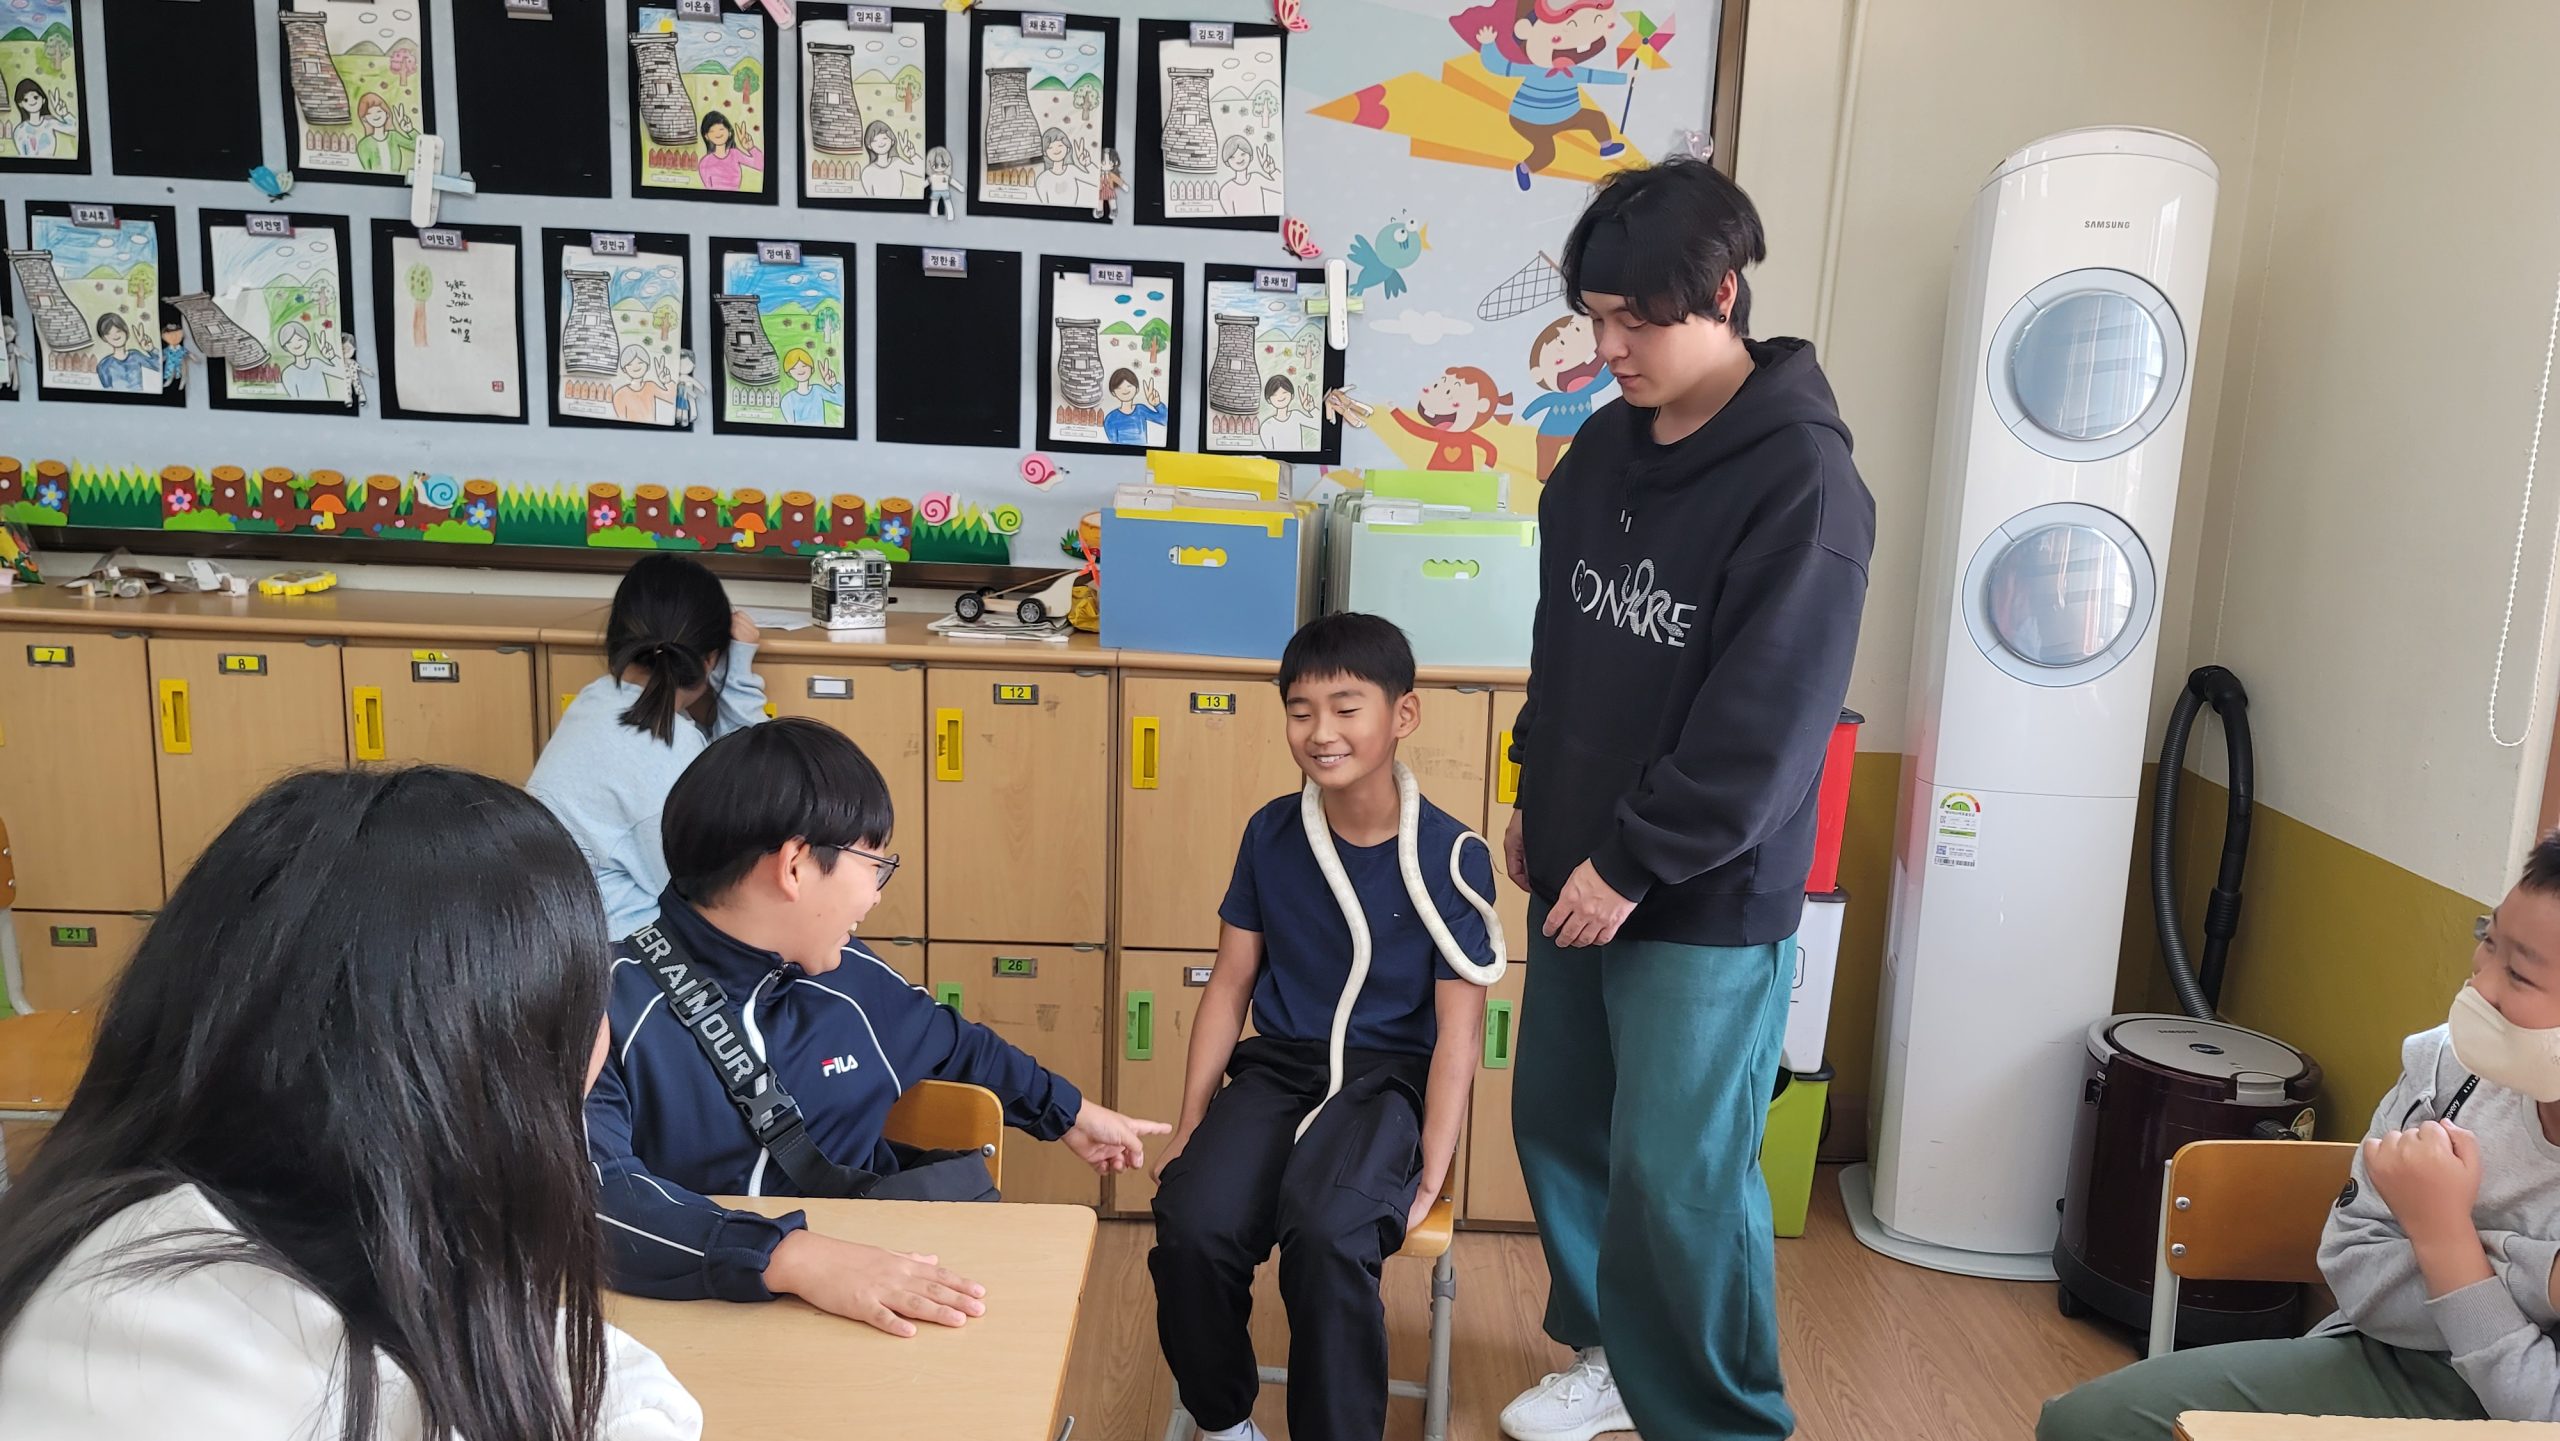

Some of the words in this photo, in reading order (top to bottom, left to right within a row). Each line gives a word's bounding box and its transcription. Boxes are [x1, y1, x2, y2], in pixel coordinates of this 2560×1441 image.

[1199, 29, 1225, 41] 김도경
[2084, 220, 2131, 230] SAMSUNG
[599, 239, 626, 252] 정민규
[1097, 269, 1125, 282] 최민준
[48, 650, 54, 661] 7
[238, 659, 245, 669] 8
[1010, 687, 1025, 699] 12
[1207, 696, 1221, 708] 13
[67, 928, 81, 939] 21
[1008, 959, 1023, 971] 26
[821, 1054, 858, 1077] FILA
